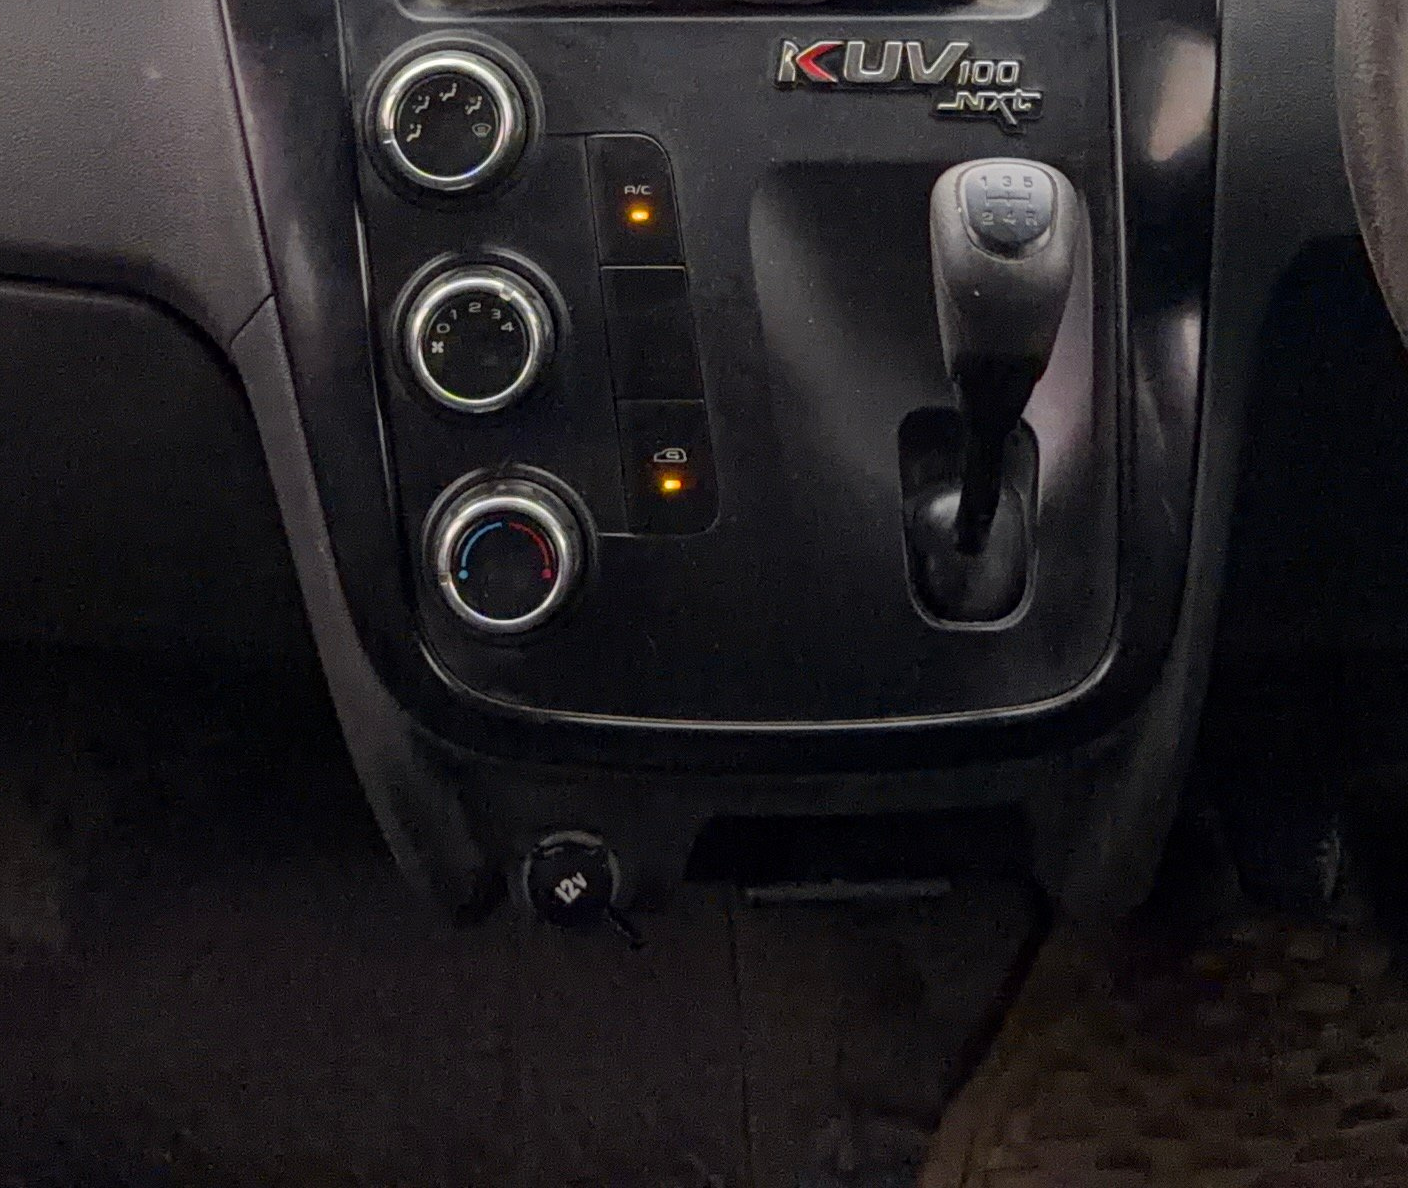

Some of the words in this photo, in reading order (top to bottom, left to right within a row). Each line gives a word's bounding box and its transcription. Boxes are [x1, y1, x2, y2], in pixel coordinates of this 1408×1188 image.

[980, 175, 988, 187] 1
[1002, 175, 1012, 187] 3
[1023, 176, 1033, 188] 5
[624, 184, 652, 196] A/C
[468, 301, 482, 313] 2
[491, 308, 502, 321] 3
[436, 322, 451, 334] 0
[500, 321, 515, 333] 4
[554, 871, 588, 904] 12V
